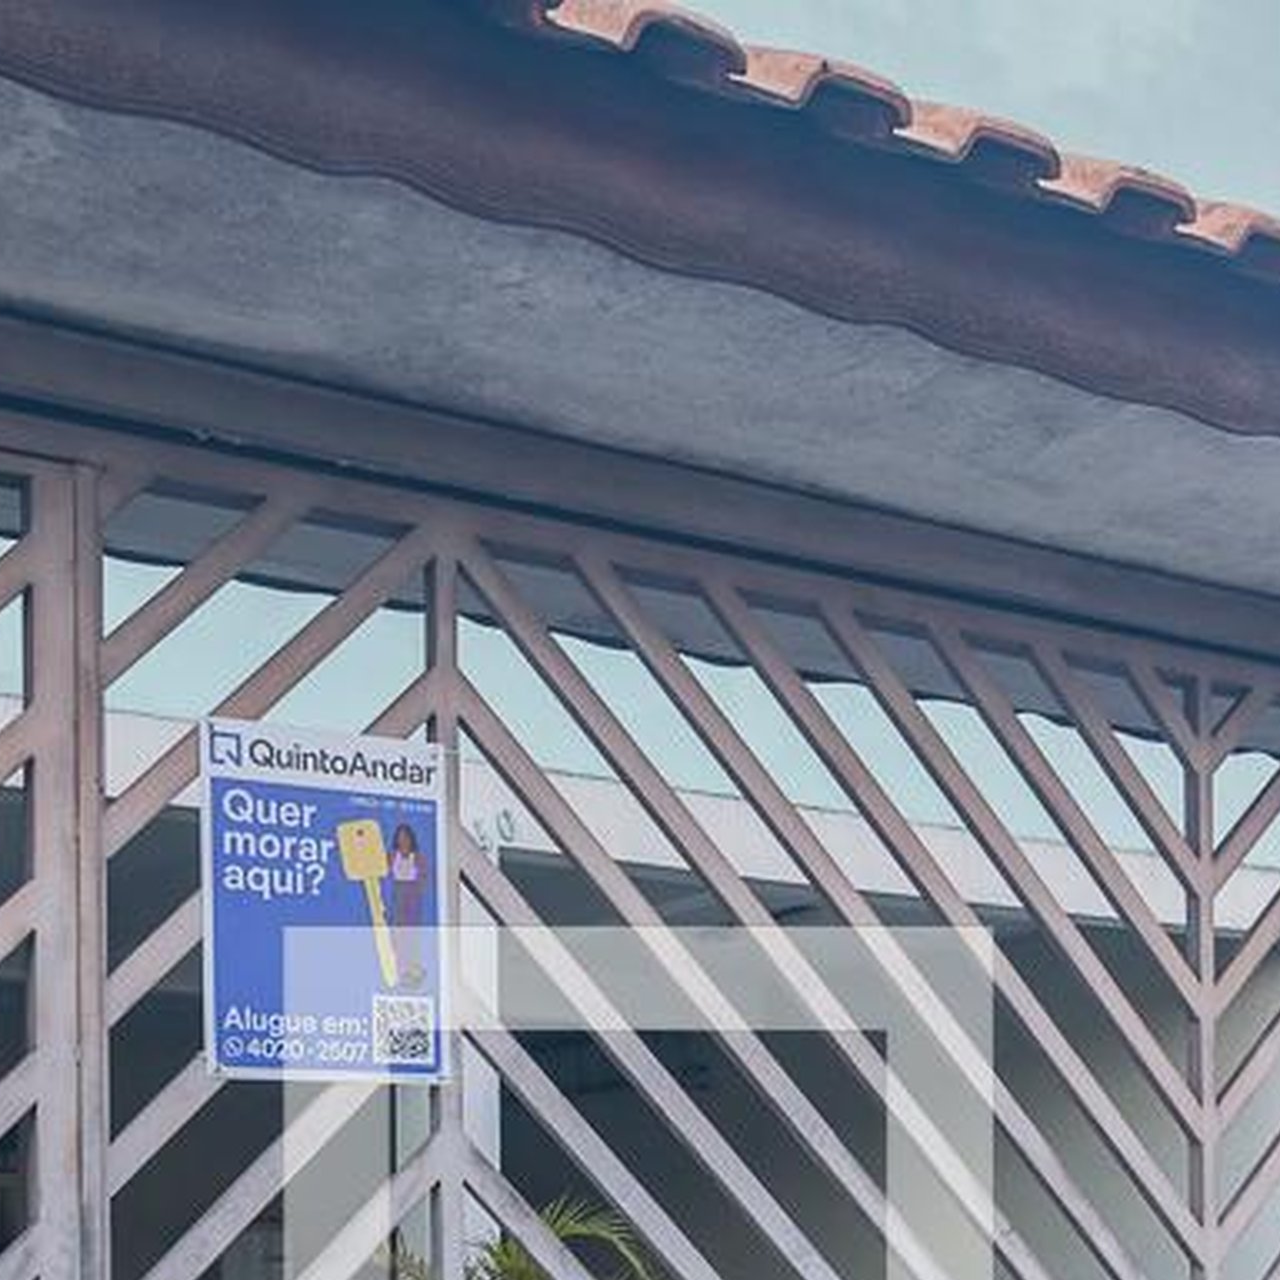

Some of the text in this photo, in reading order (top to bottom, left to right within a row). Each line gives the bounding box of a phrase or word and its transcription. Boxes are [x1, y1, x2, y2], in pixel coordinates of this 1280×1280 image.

[248, 739, 437, 785] QuintoAndar
[223, 789, 317, 828] Quer
[224, 832, 334, 862] morar
[223, 863, 325, 900] aqui?
[223, 1005, 369, 1037] Alugue em:
